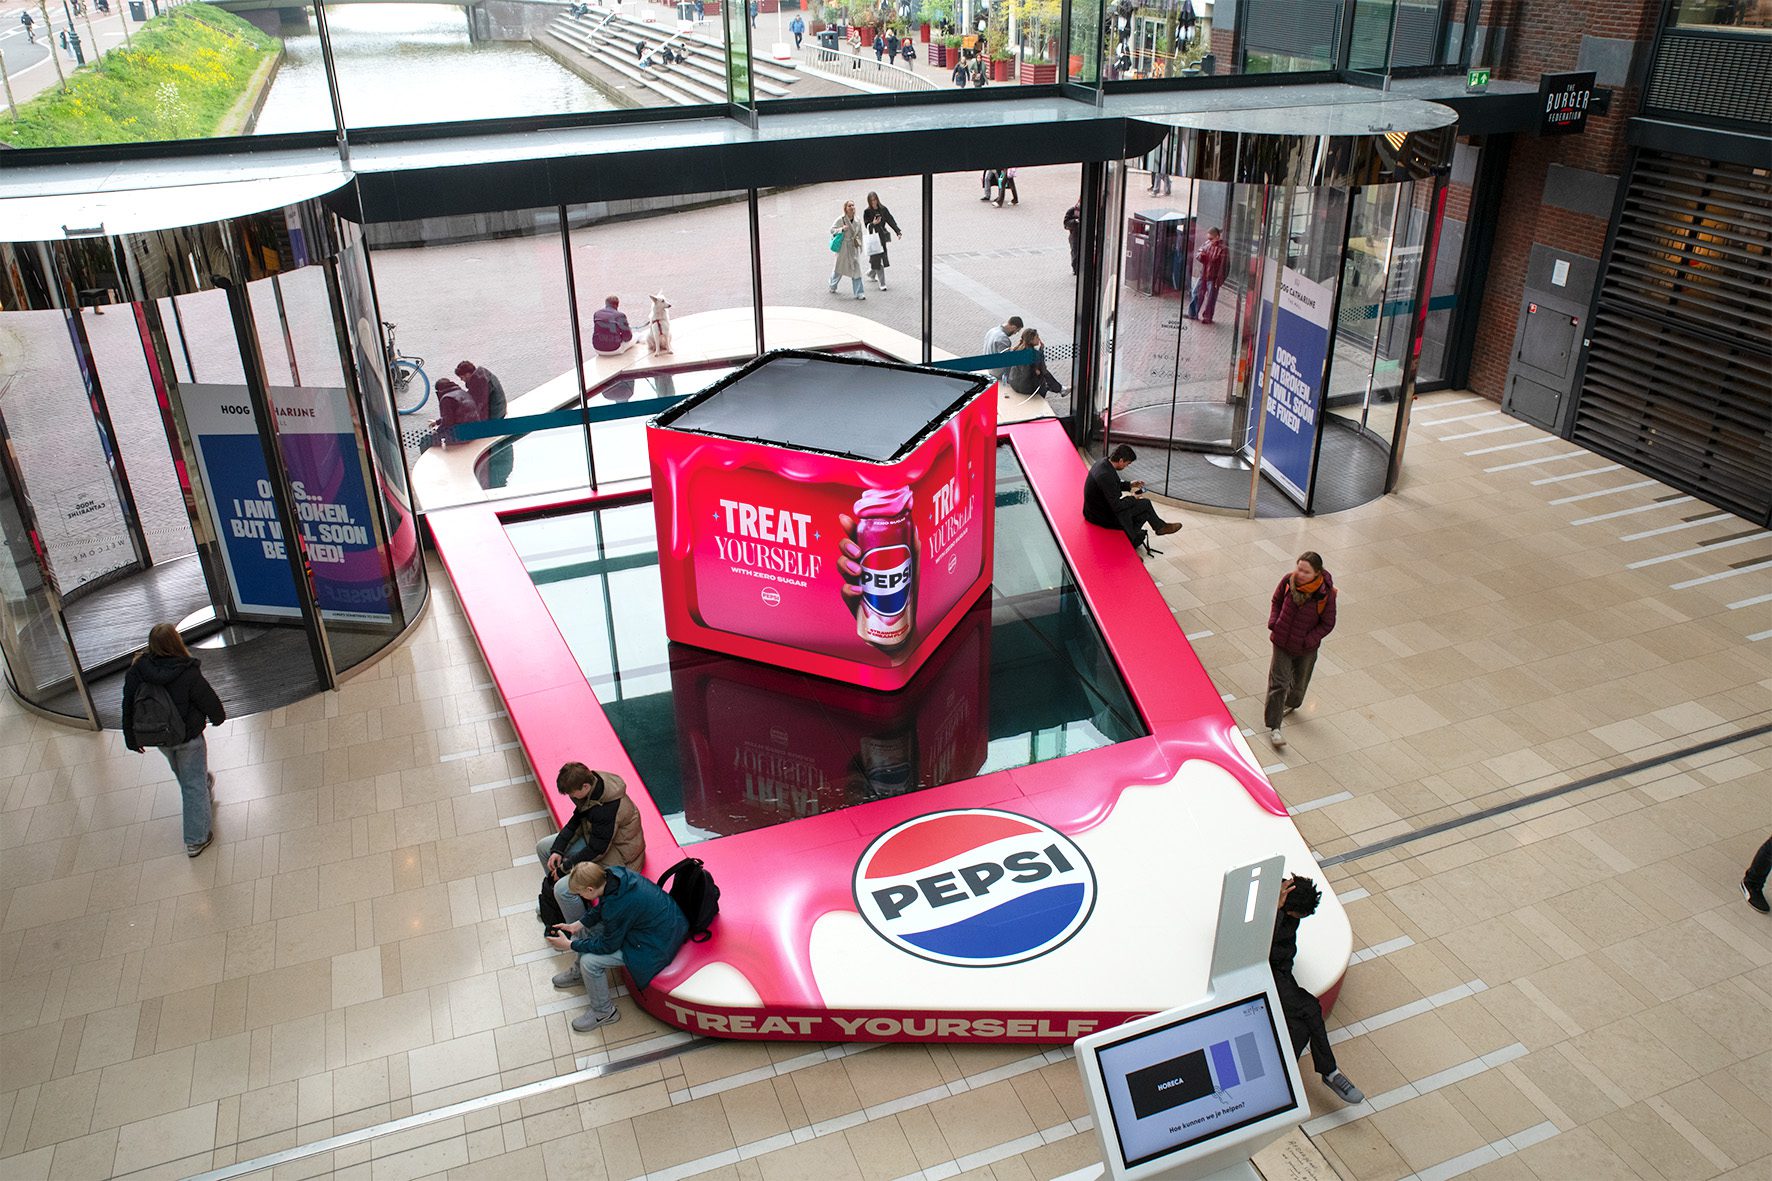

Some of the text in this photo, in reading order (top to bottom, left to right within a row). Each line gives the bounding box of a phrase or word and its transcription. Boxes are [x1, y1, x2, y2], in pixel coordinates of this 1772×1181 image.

[1566, 84, 1576, 92] THE
[1546, 90, 1590, 113] BURGER
[1548, 111, 1582, 122] FEDERATION
[1276, 346, 1303, 378] OOPS...
[1258, 371, 1315, 426] BT WILL SOON
[1279, 371, 1312, 404] BROKEN,
[220, 405, 316, 418] HOOG HARIJNE
[1267, 395, 1301, 434] BE FIXED!
[256, 479, 323, 502] OS...
[233, 499, 355, 525] I AM OKEN,
[719, 498, 812, 548] TREAT
[230, 519, 369, 545] BUT WL SOON
[262, 541, 346, 564] BE XED!
[714, 535, 822, 579] YOURSELF
[730, 566, 808, 588] WITH ZERO SUGAR
[870, 843, 1075, 921] PEPSI
[664, 1001, 1099, 1038] TREAT YOURSELF
[1157, 1077, 1185, 1092] HORECA
[1168, 1101, 1246, 1134] Hoe kunnen we je helpen?
